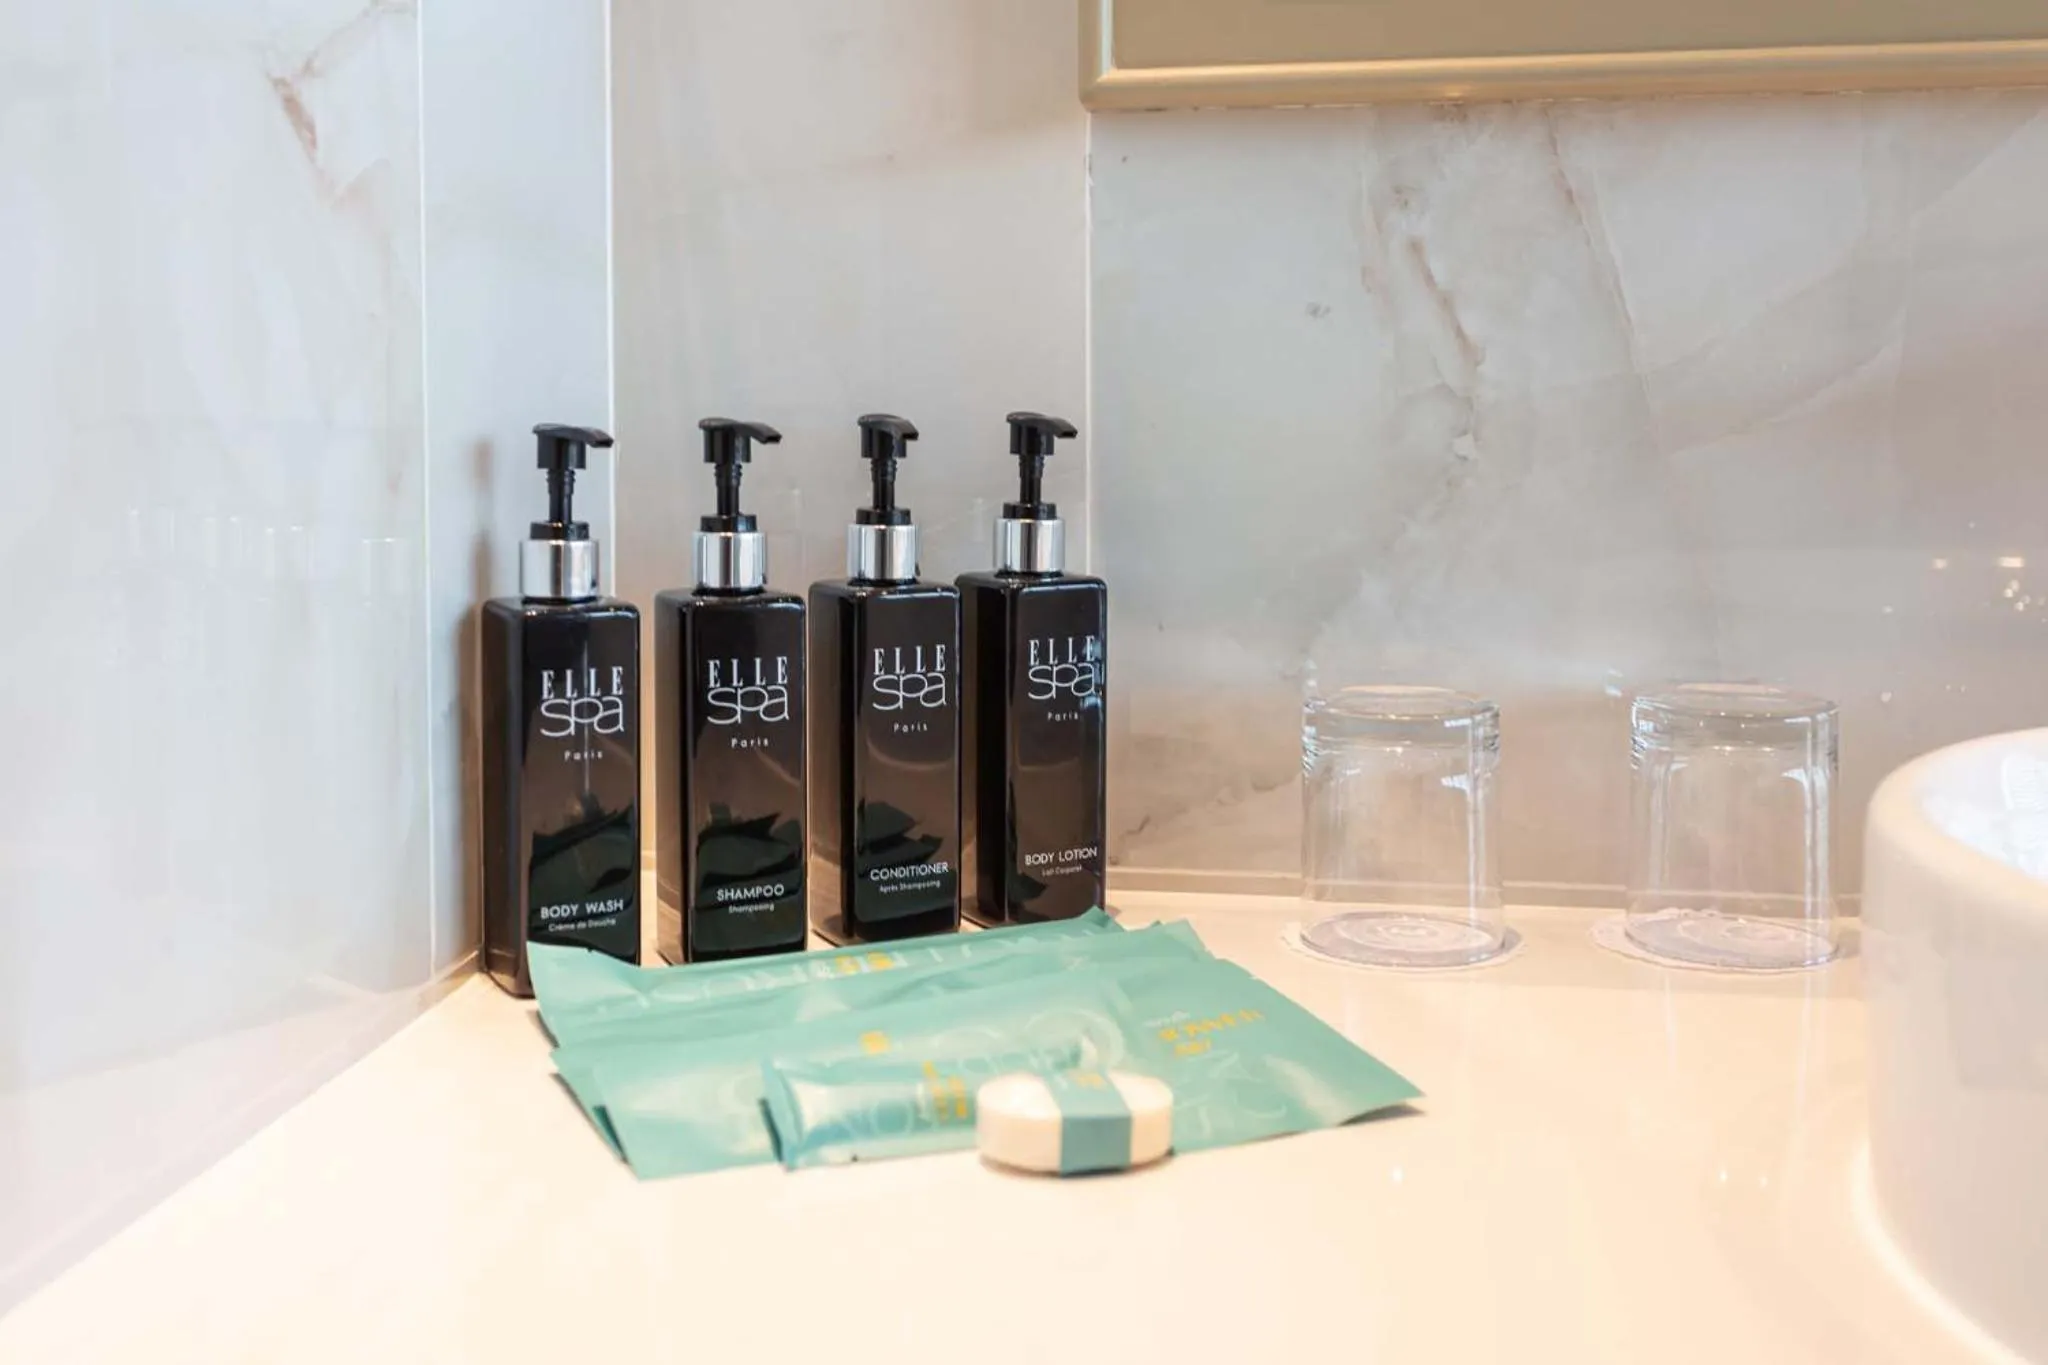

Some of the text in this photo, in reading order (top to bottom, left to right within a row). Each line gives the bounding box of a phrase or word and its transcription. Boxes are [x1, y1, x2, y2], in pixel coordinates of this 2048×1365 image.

[873, 644, 947, 675] ELLE
[1028, 635, 1096, 666] ELLE
[541, 666, 624, 699] ELLE
[707, 656, 788, 688] ELLE
[1027, 662, 1098, 700] spa
[707, 685, 790, 724] spa
[872, 672, 947, 710] spa
[540, 696, 625, 737] spa
[893, 722, 929, 733] Paris
[1047, 711, 1080, 721] Paris
[564, 750, 603, 762] Paris
[731, 736, 769, 749] Paris
[1024, 846, 1098, 867] BODY LOTION
[870, 861, 950, 882] CONDITIONER
[716, 883, 785, 902] SHAMPOO
[540, 898, 624, 921] BODY WASH
